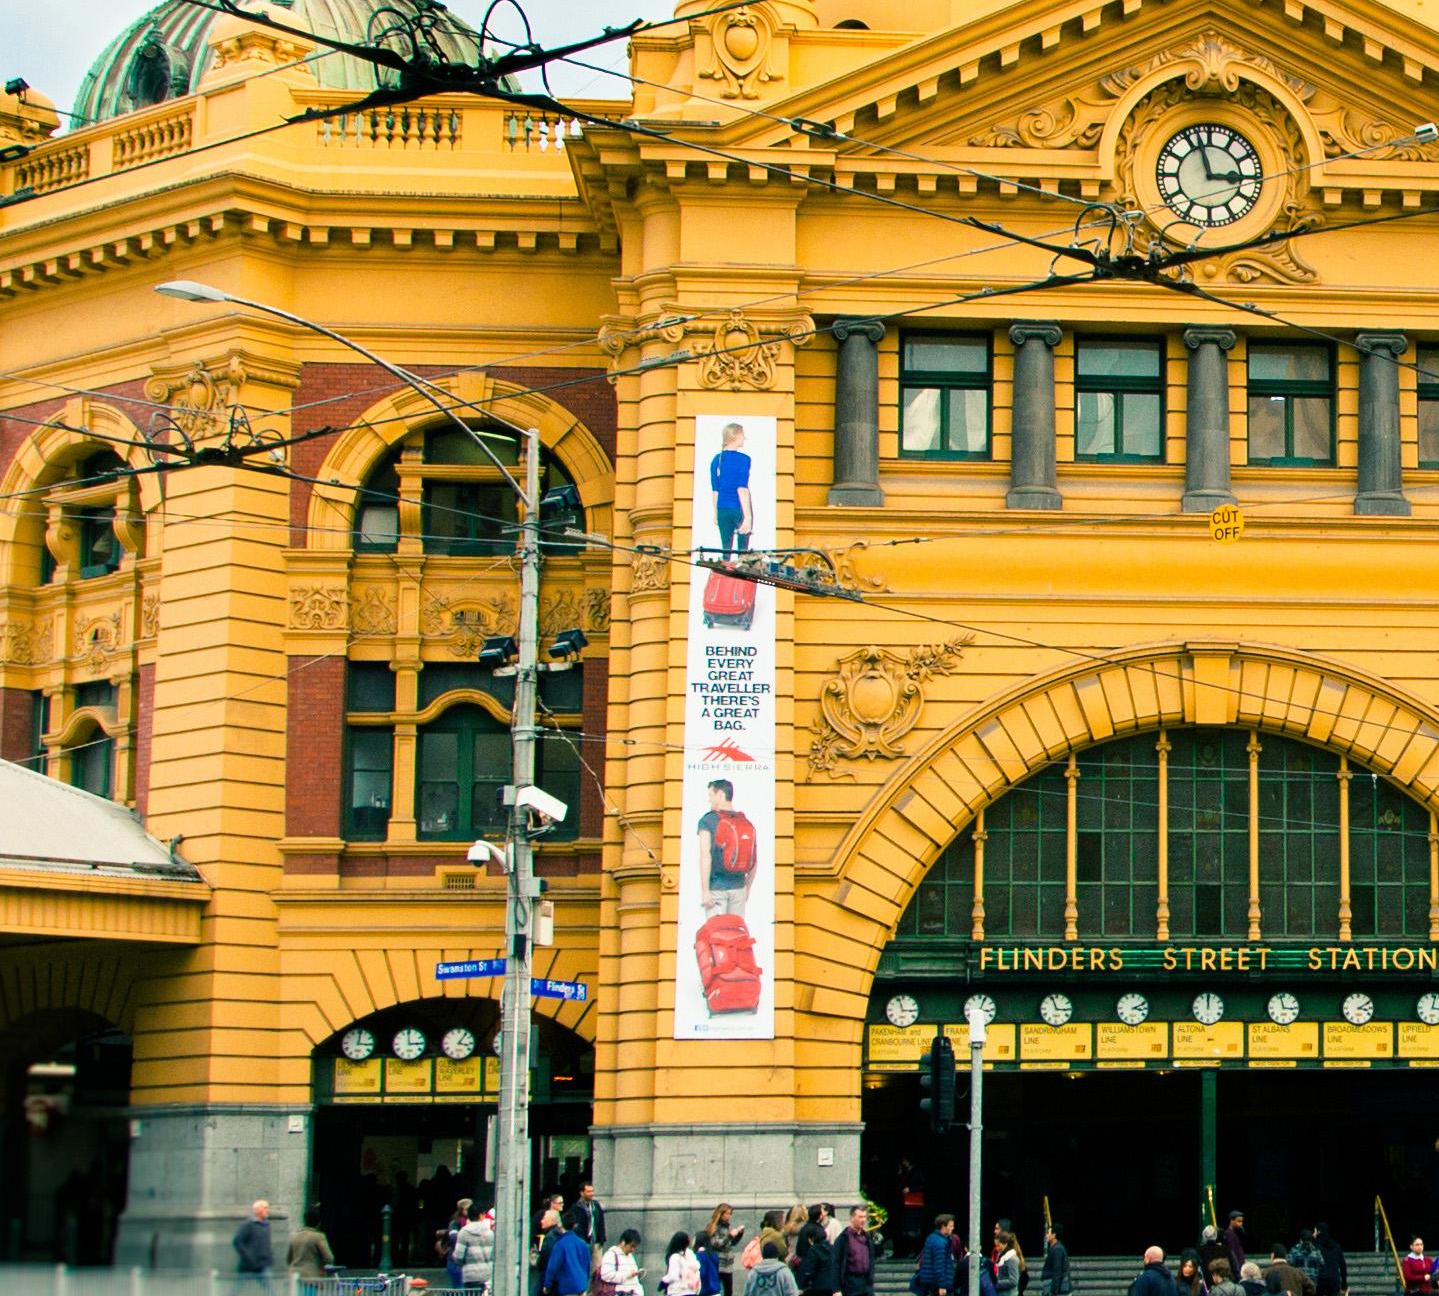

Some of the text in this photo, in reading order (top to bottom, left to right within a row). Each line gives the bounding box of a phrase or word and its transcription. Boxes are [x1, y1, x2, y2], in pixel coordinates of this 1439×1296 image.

[705, 646, 757, 656] BEHIND
[707, 658, 754, 668] EVERY
[707, 671, 754, 681] GREAT
[691, 683, 771, 693] TRAVELLER
[701, 695, 760, 706] THERE'S
[701, 708, 760, 718] A GREAT
[714, 720, 746, 730] BAG.
[979, 947, 1438, 971] FLINDERS STREET STATION
[438, 963, 477, 975] Swanston
[478, 961, 487, 972] St
[871, 1027, 906, 1036] PAKENHAM
[1101, 1025, 1156, 1034] WILLIAMSTOWN
[1177, 1025, 1205, 1033] ALTONA
[1252, 1025, 1290, 1033] ST ALBANS
[1328, 1025, 1388, 1033] BROADMEADOWS
[1402, 1025, 1431, 1033] UPFIELD
[1024, 1036, 1039, 1044] LINE
[1101, 1035, 1117, 1043] LINE
[1252, 1035, 1268, 1043] LINE
[1327, 1035, 1343, 1043] LINE
[1402, 1035, 1417, 1043] LINE
